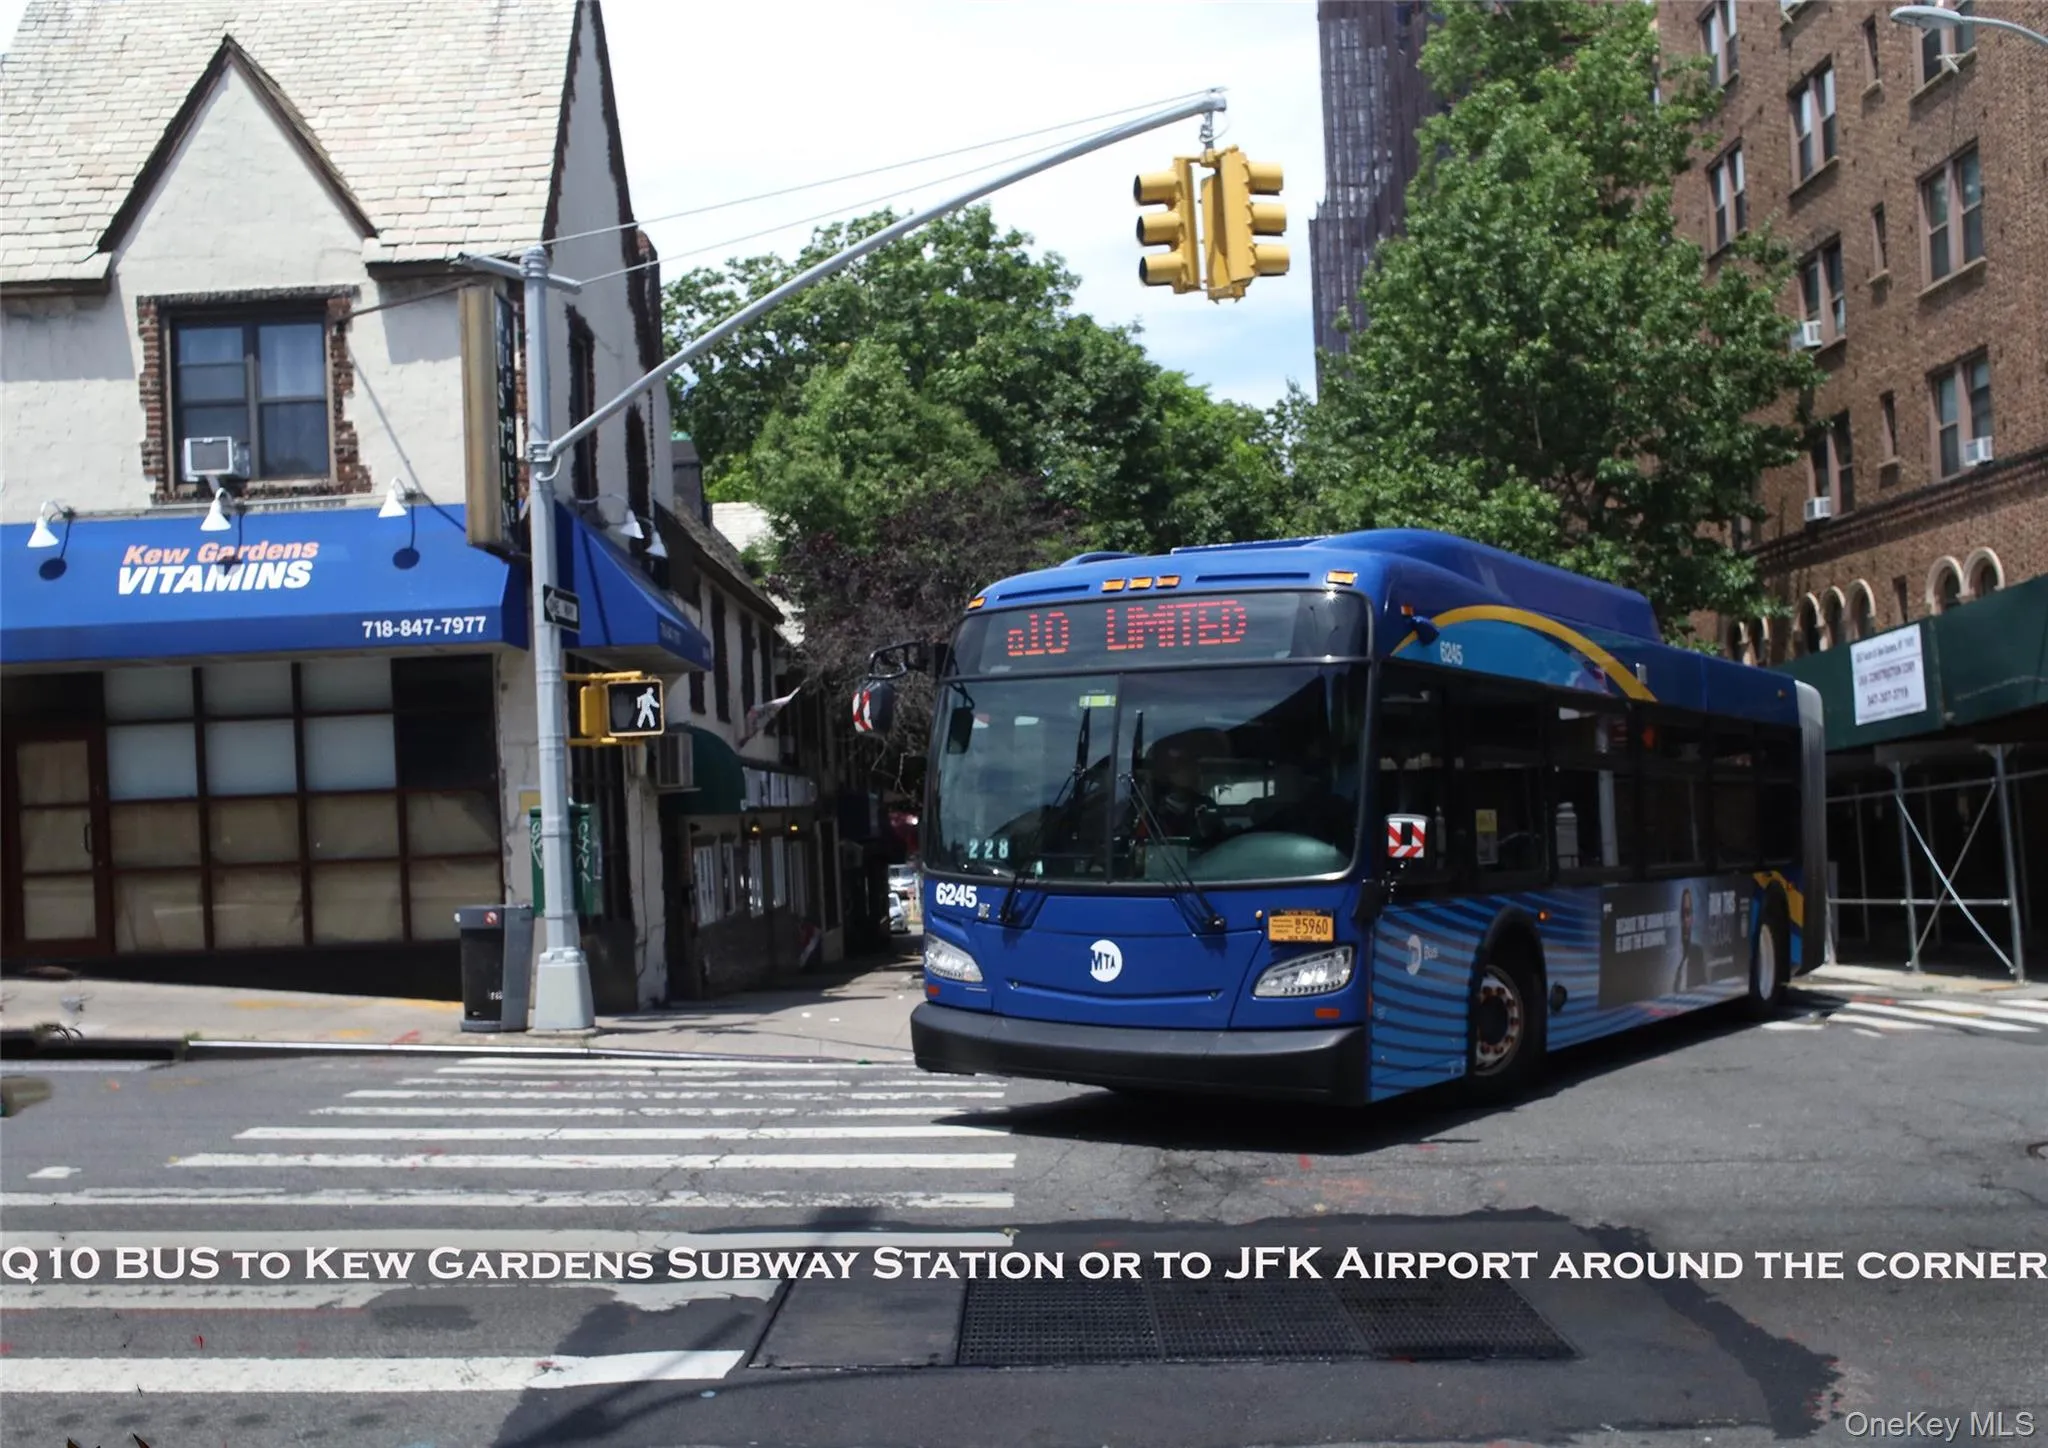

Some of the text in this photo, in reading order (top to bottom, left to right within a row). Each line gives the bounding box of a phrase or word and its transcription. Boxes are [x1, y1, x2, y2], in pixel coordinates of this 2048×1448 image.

[122, 540, 319, 566] Kew Gardens
[117, 560, 314, 596] VITAMINS
[361, 615, 487, 639] 718-847-7977
[1107, 600, 1246, 650] LIMITED
[1440, 640, 1463, 666] 6245
[935, 882, 978, 908] 6245
[1302, 918, 1329, 934] 5960
[1089, 949, 1116, 971] MTA
